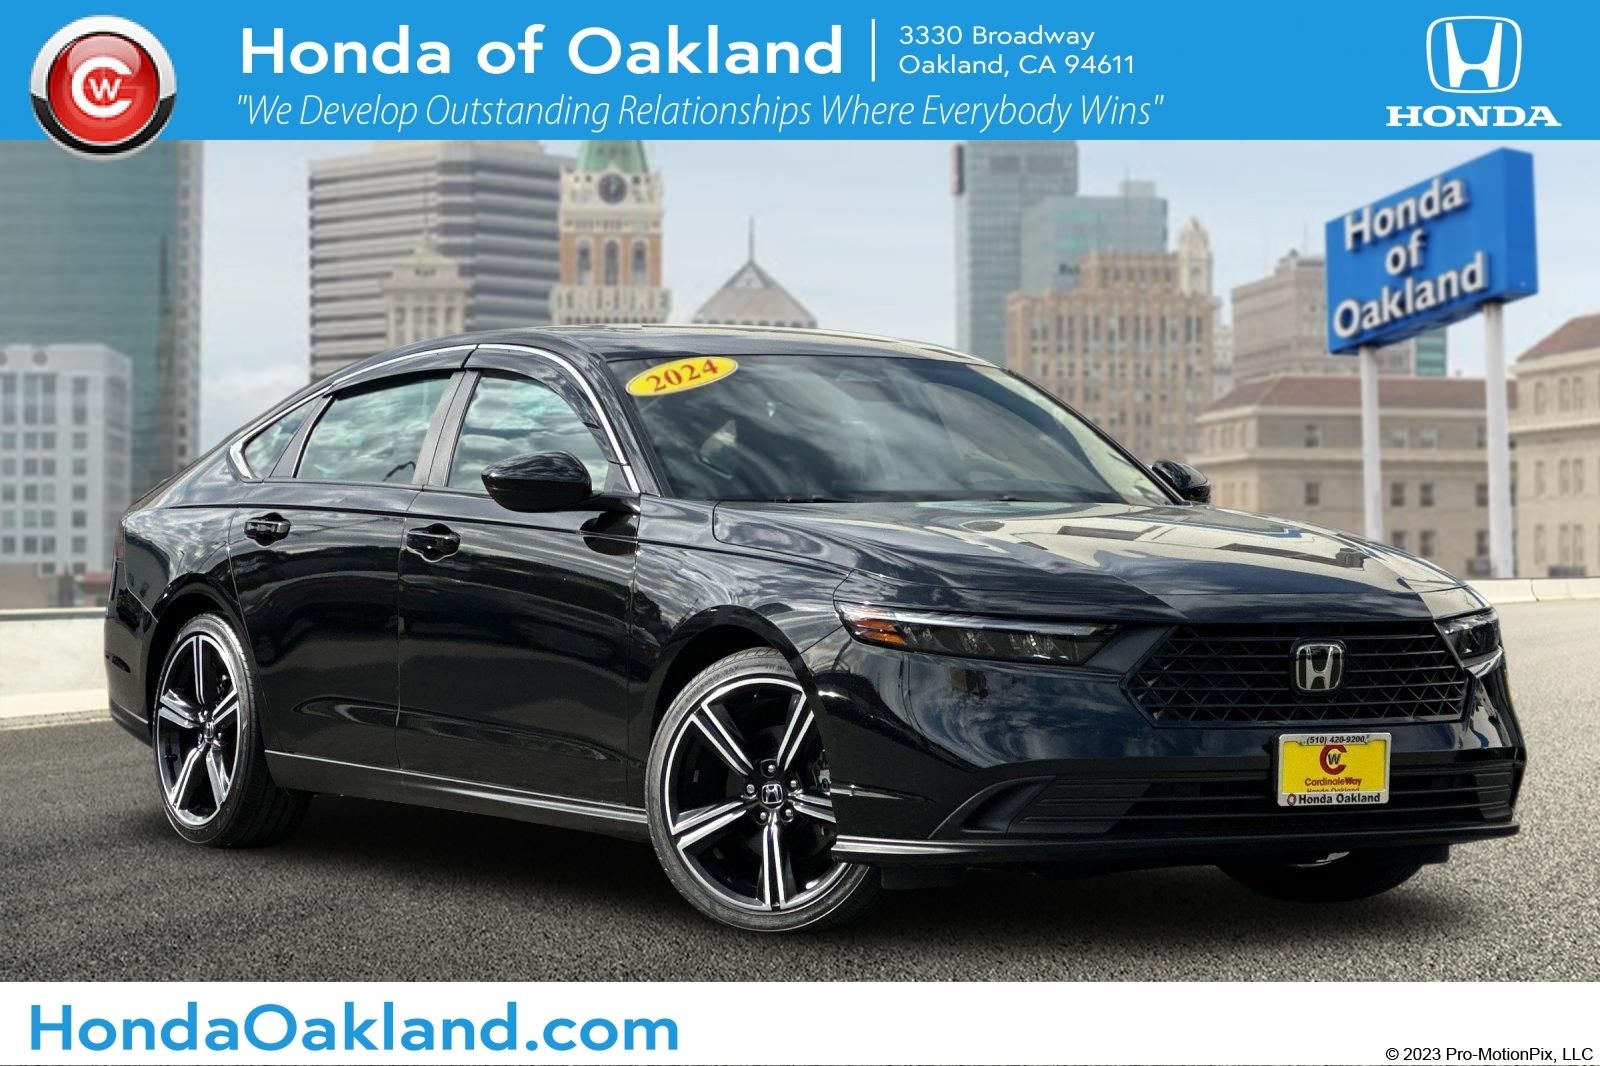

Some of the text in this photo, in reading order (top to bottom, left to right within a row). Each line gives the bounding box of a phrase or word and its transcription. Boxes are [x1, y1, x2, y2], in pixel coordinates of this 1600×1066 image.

[1344, 174, 1468, 251] Honda
[1385, 229, 1427, 275] of
[1333, 250, 1489, 338] Oakland
[646, 359, 718, 392] 2024
[1306, 735, 1365, 745] (510) 420-9200
[1299, 794, 1333, 805] Honda
[1336, 793, 1381, 804] Oakland
